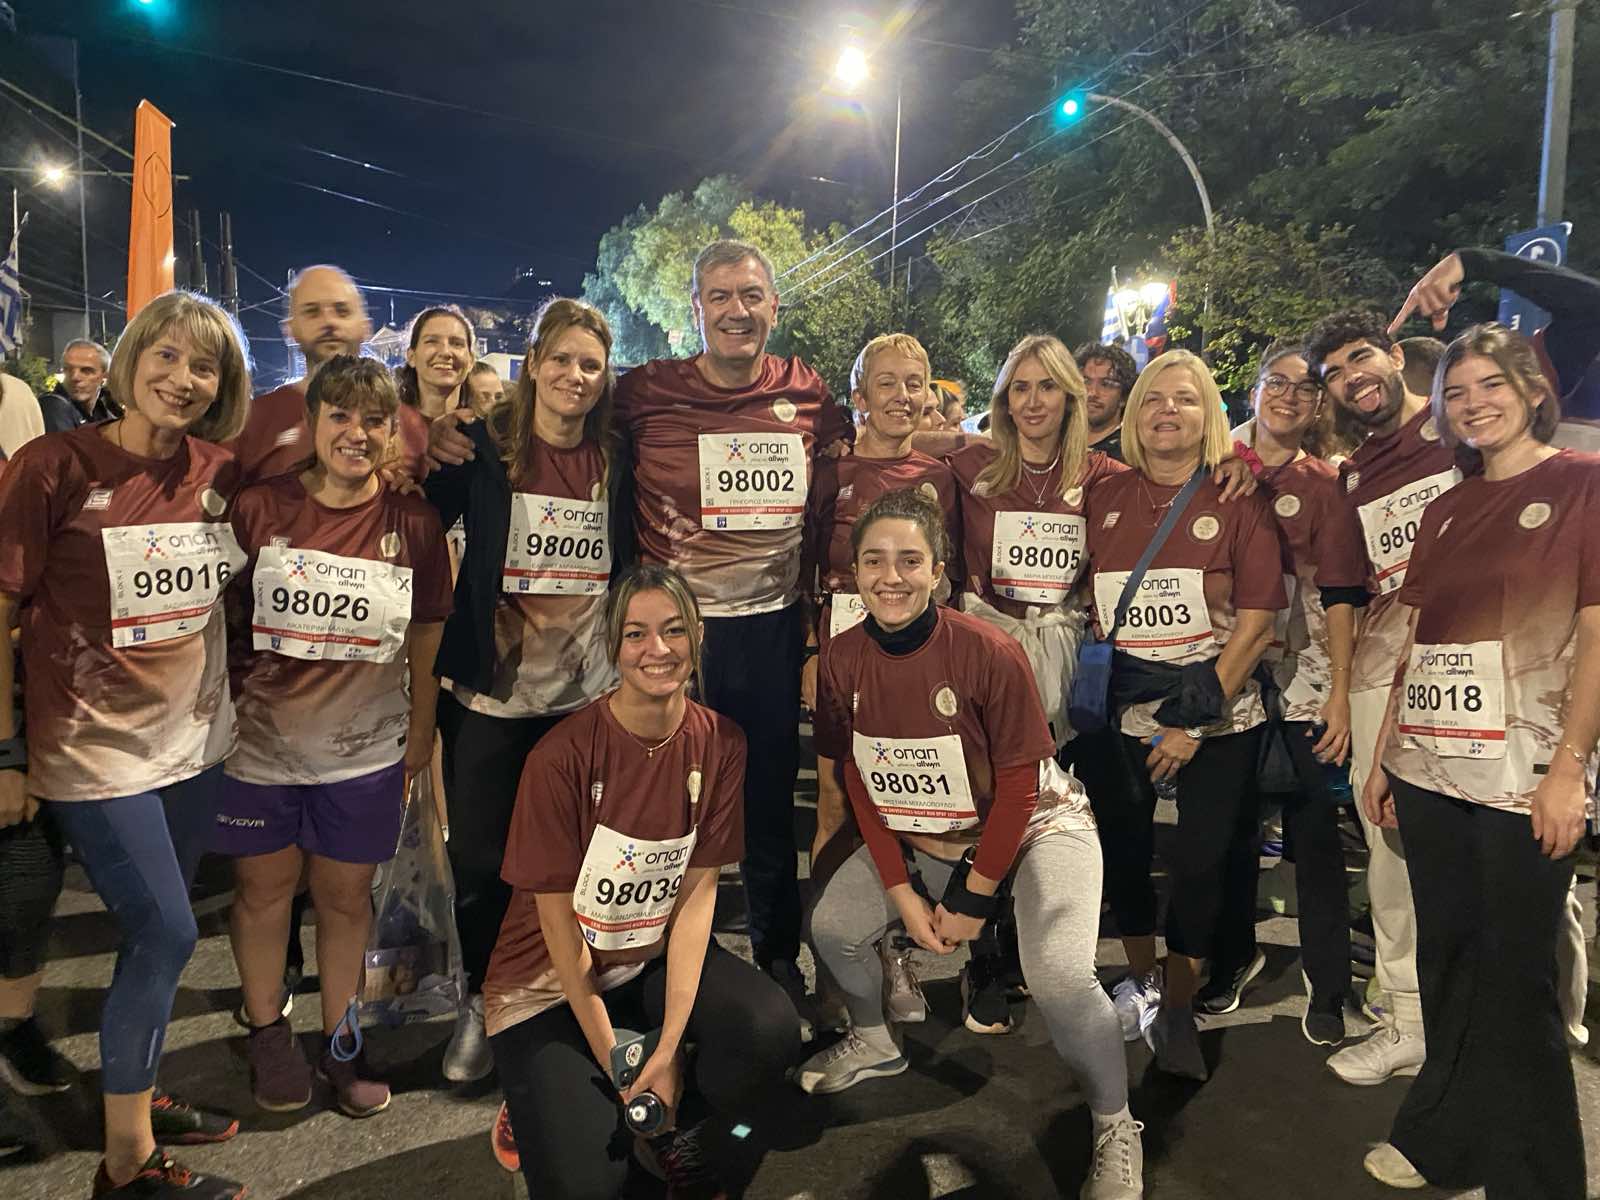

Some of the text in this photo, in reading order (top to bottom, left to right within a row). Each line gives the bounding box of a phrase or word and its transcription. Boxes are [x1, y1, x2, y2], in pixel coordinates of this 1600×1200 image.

[717, 469, 795, 493] 98002
[526, 533, 604, 560] 98006
[1380, 521, 1418, 554] 980
[1009, 545, 1080, 570] 98005
[133, 561, 231, 598] 98016
[271, 587, 370, 621] 98026
[1407, 684, 1482, 712] 98018
[870, 771, 950, 796] 98031
[595, 874, 683, 906] 98039
